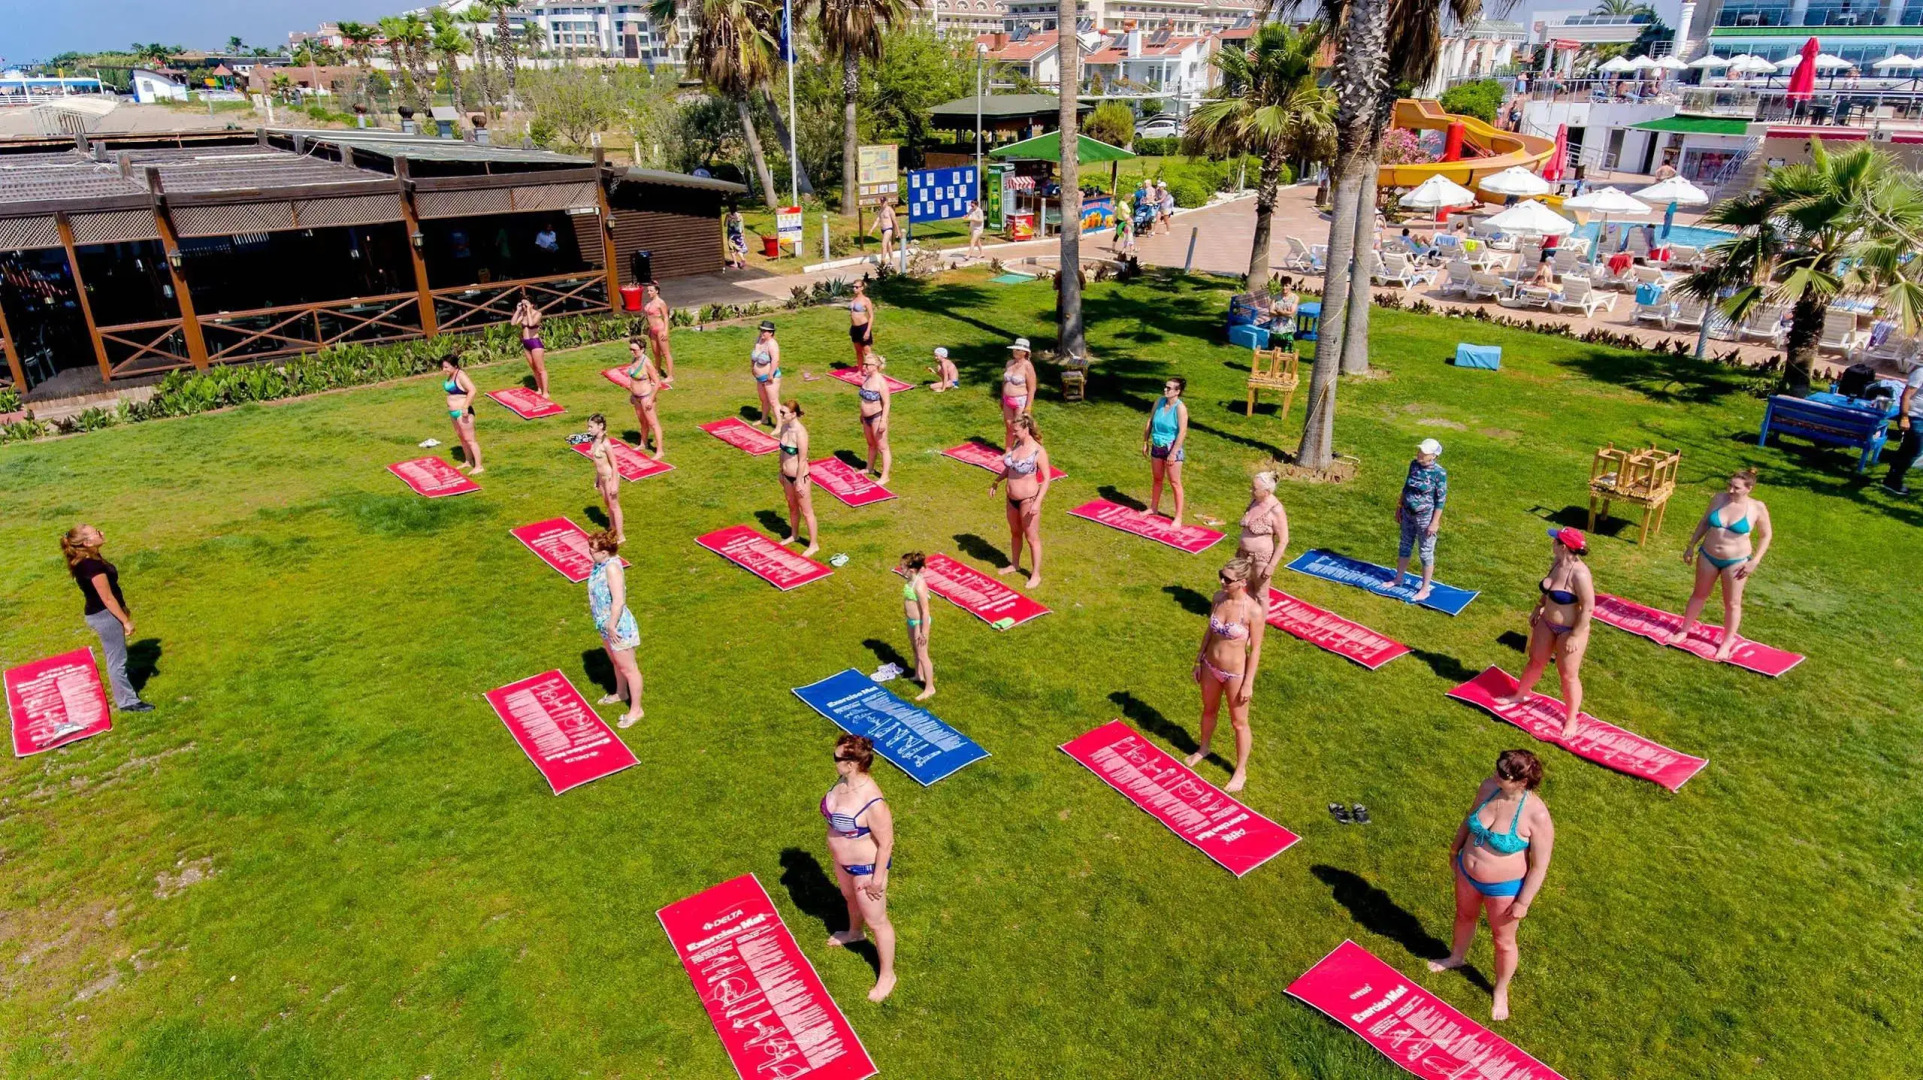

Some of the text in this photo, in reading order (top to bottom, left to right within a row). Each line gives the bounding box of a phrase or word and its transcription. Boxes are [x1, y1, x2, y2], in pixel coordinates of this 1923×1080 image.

[686, 913, 766, 952] Exercise Mat
[713, 909, 743, 927] DELTA
[1351, 998, 1392, 1024] Exercise
[1385, 984, 1408, 1002] Mat
